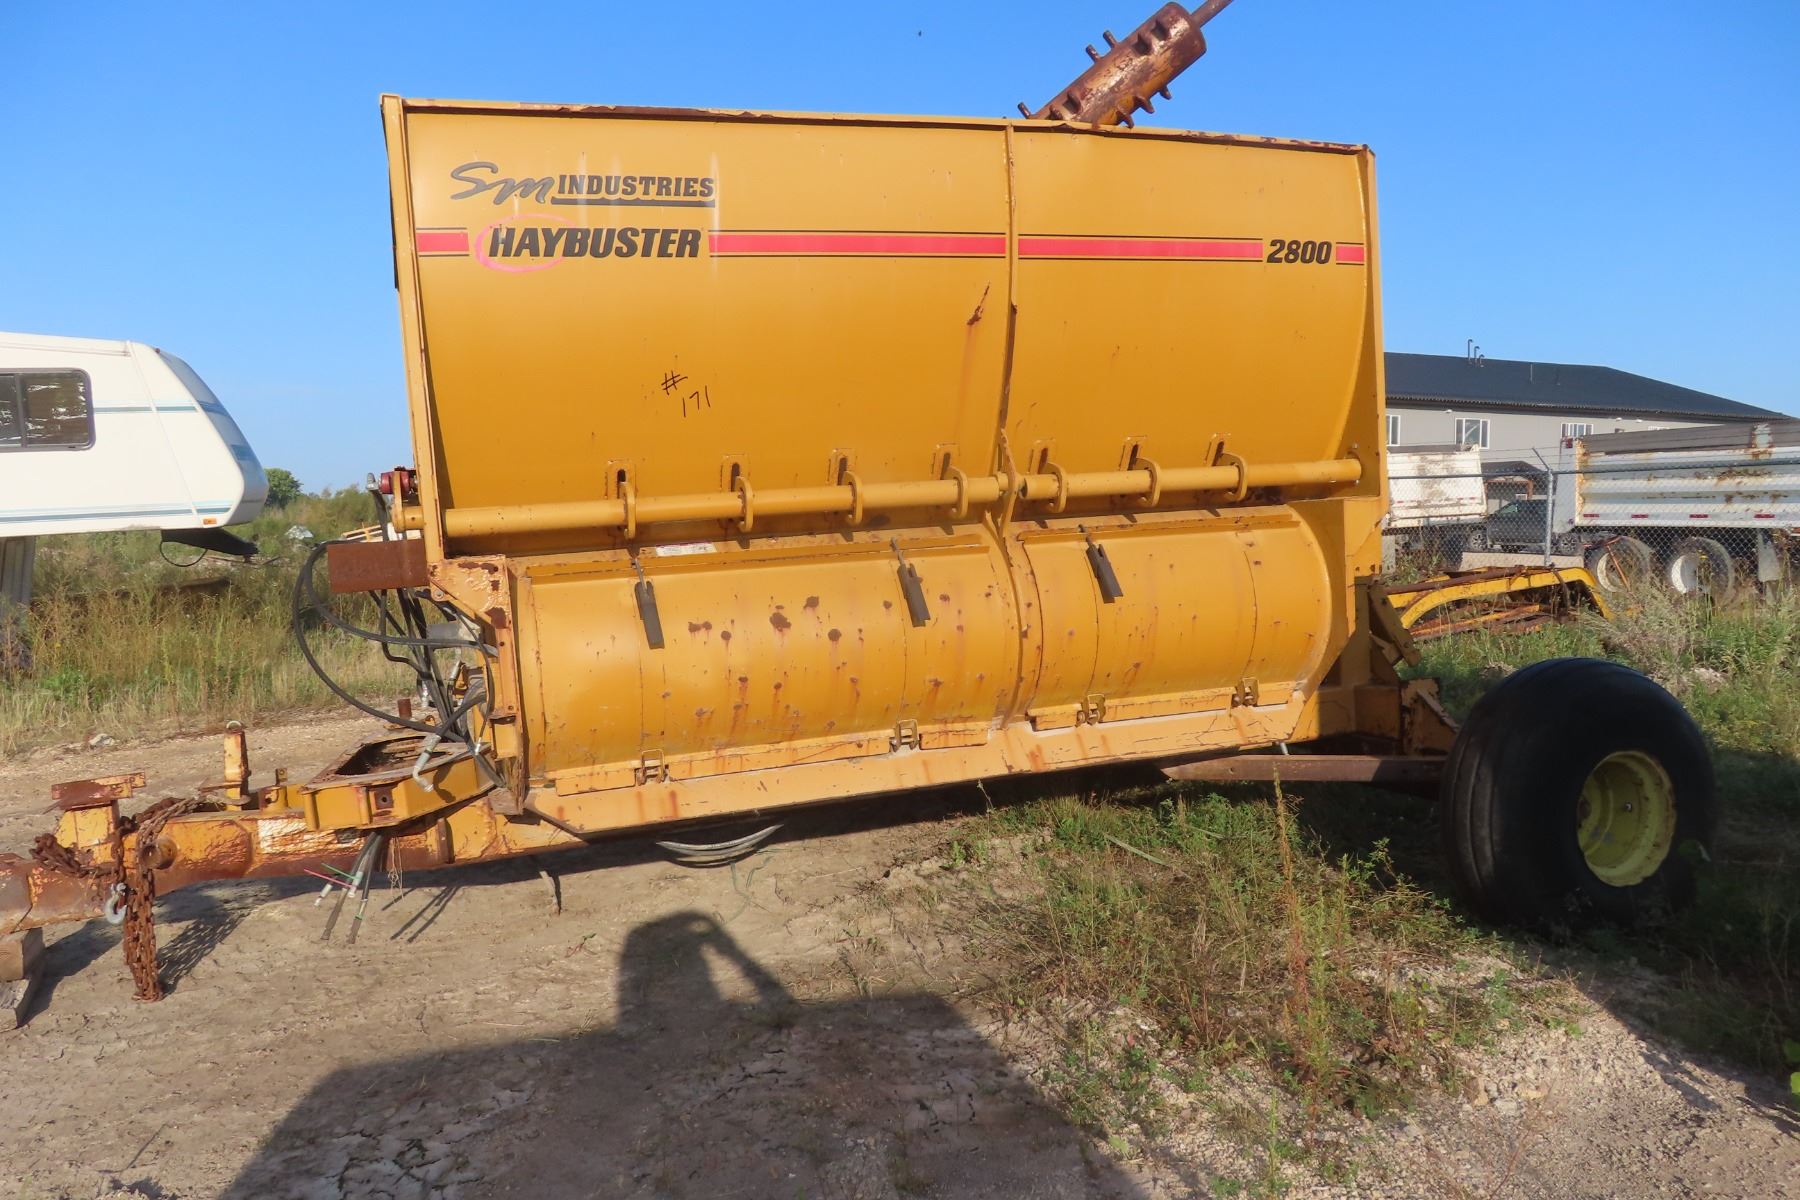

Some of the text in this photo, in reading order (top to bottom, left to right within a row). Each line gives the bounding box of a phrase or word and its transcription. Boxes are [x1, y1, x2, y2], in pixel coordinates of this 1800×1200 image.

[558, 174, 714, 197] INDUSTRIES
[488, 227, 701, 258] HAYBUSTER
[1266, 239, 1333, 264] 2800
